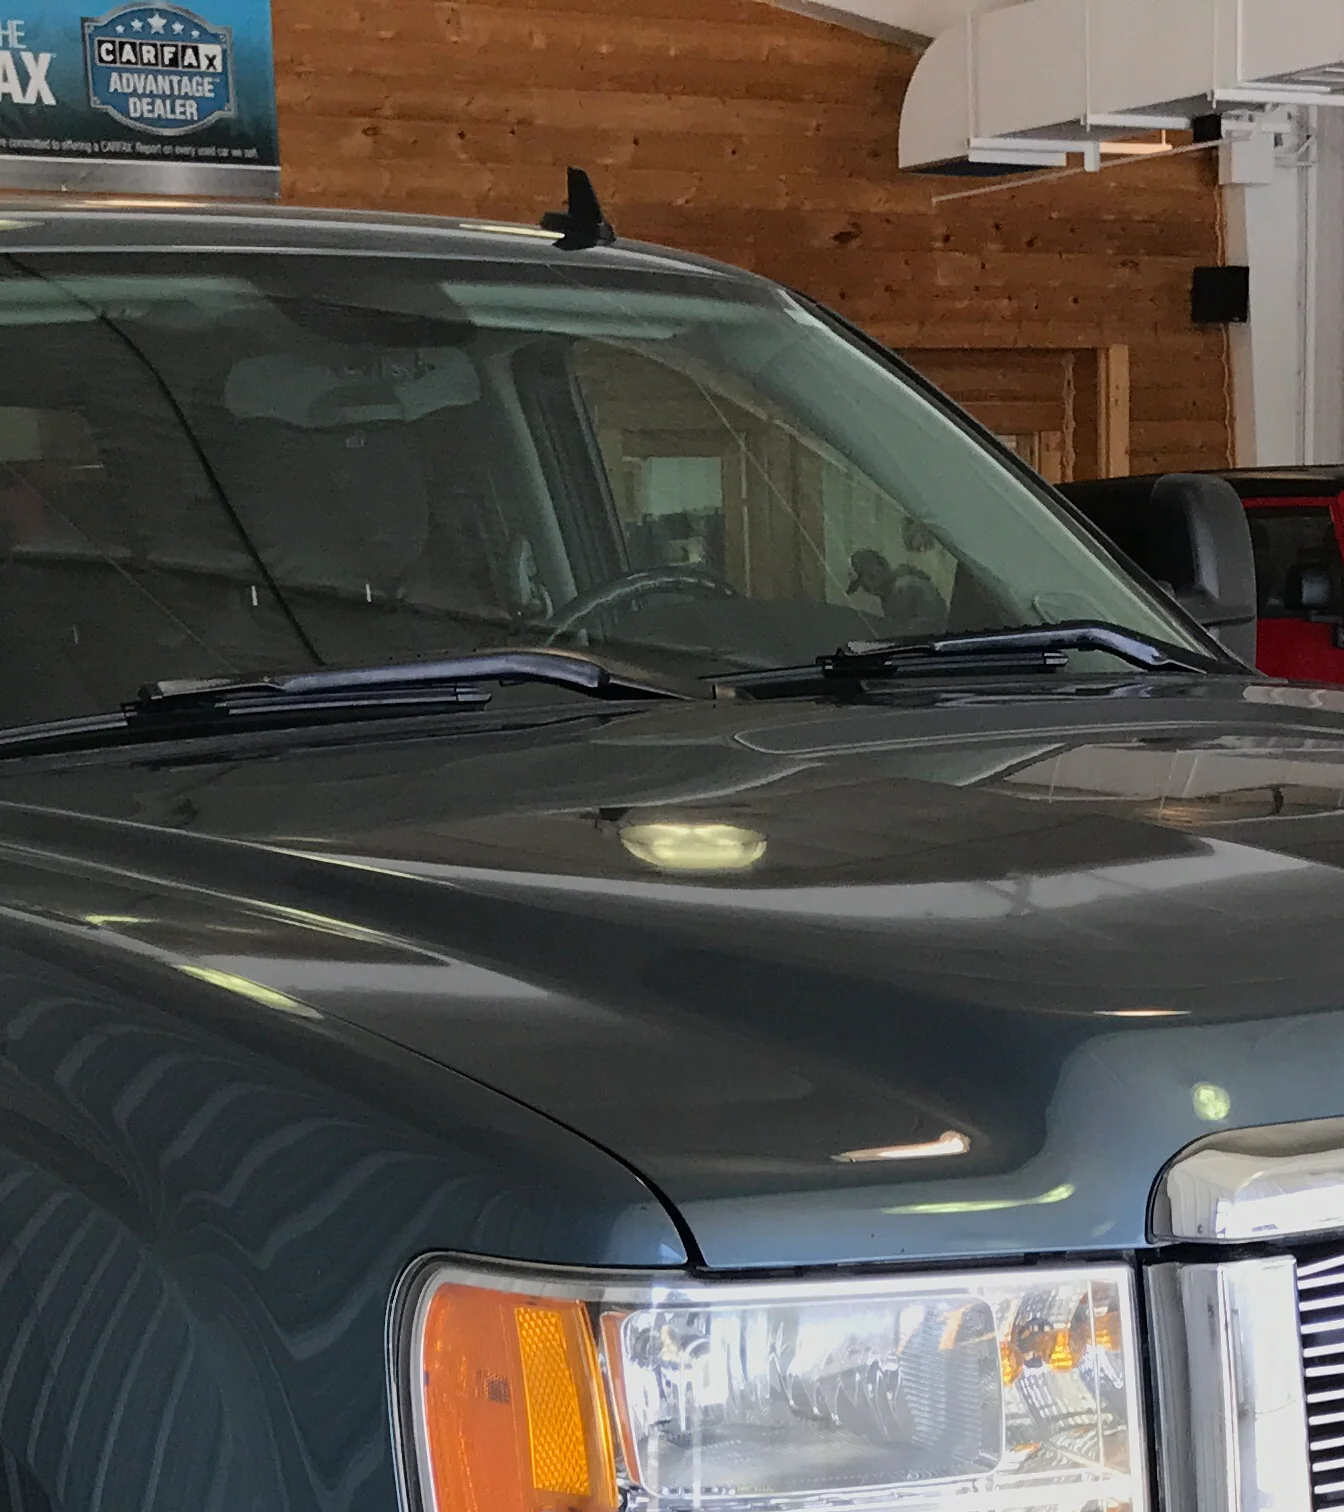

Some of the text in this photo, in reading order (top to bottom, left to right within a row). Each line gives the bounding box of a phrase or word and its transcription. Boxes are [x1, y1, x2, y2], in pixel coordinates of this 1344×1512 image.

[100, 42, 218, 71] CARFAX
[109, 72, 215, 98] ADVANTAGE
[128, 97, 198, 120] DEALER
